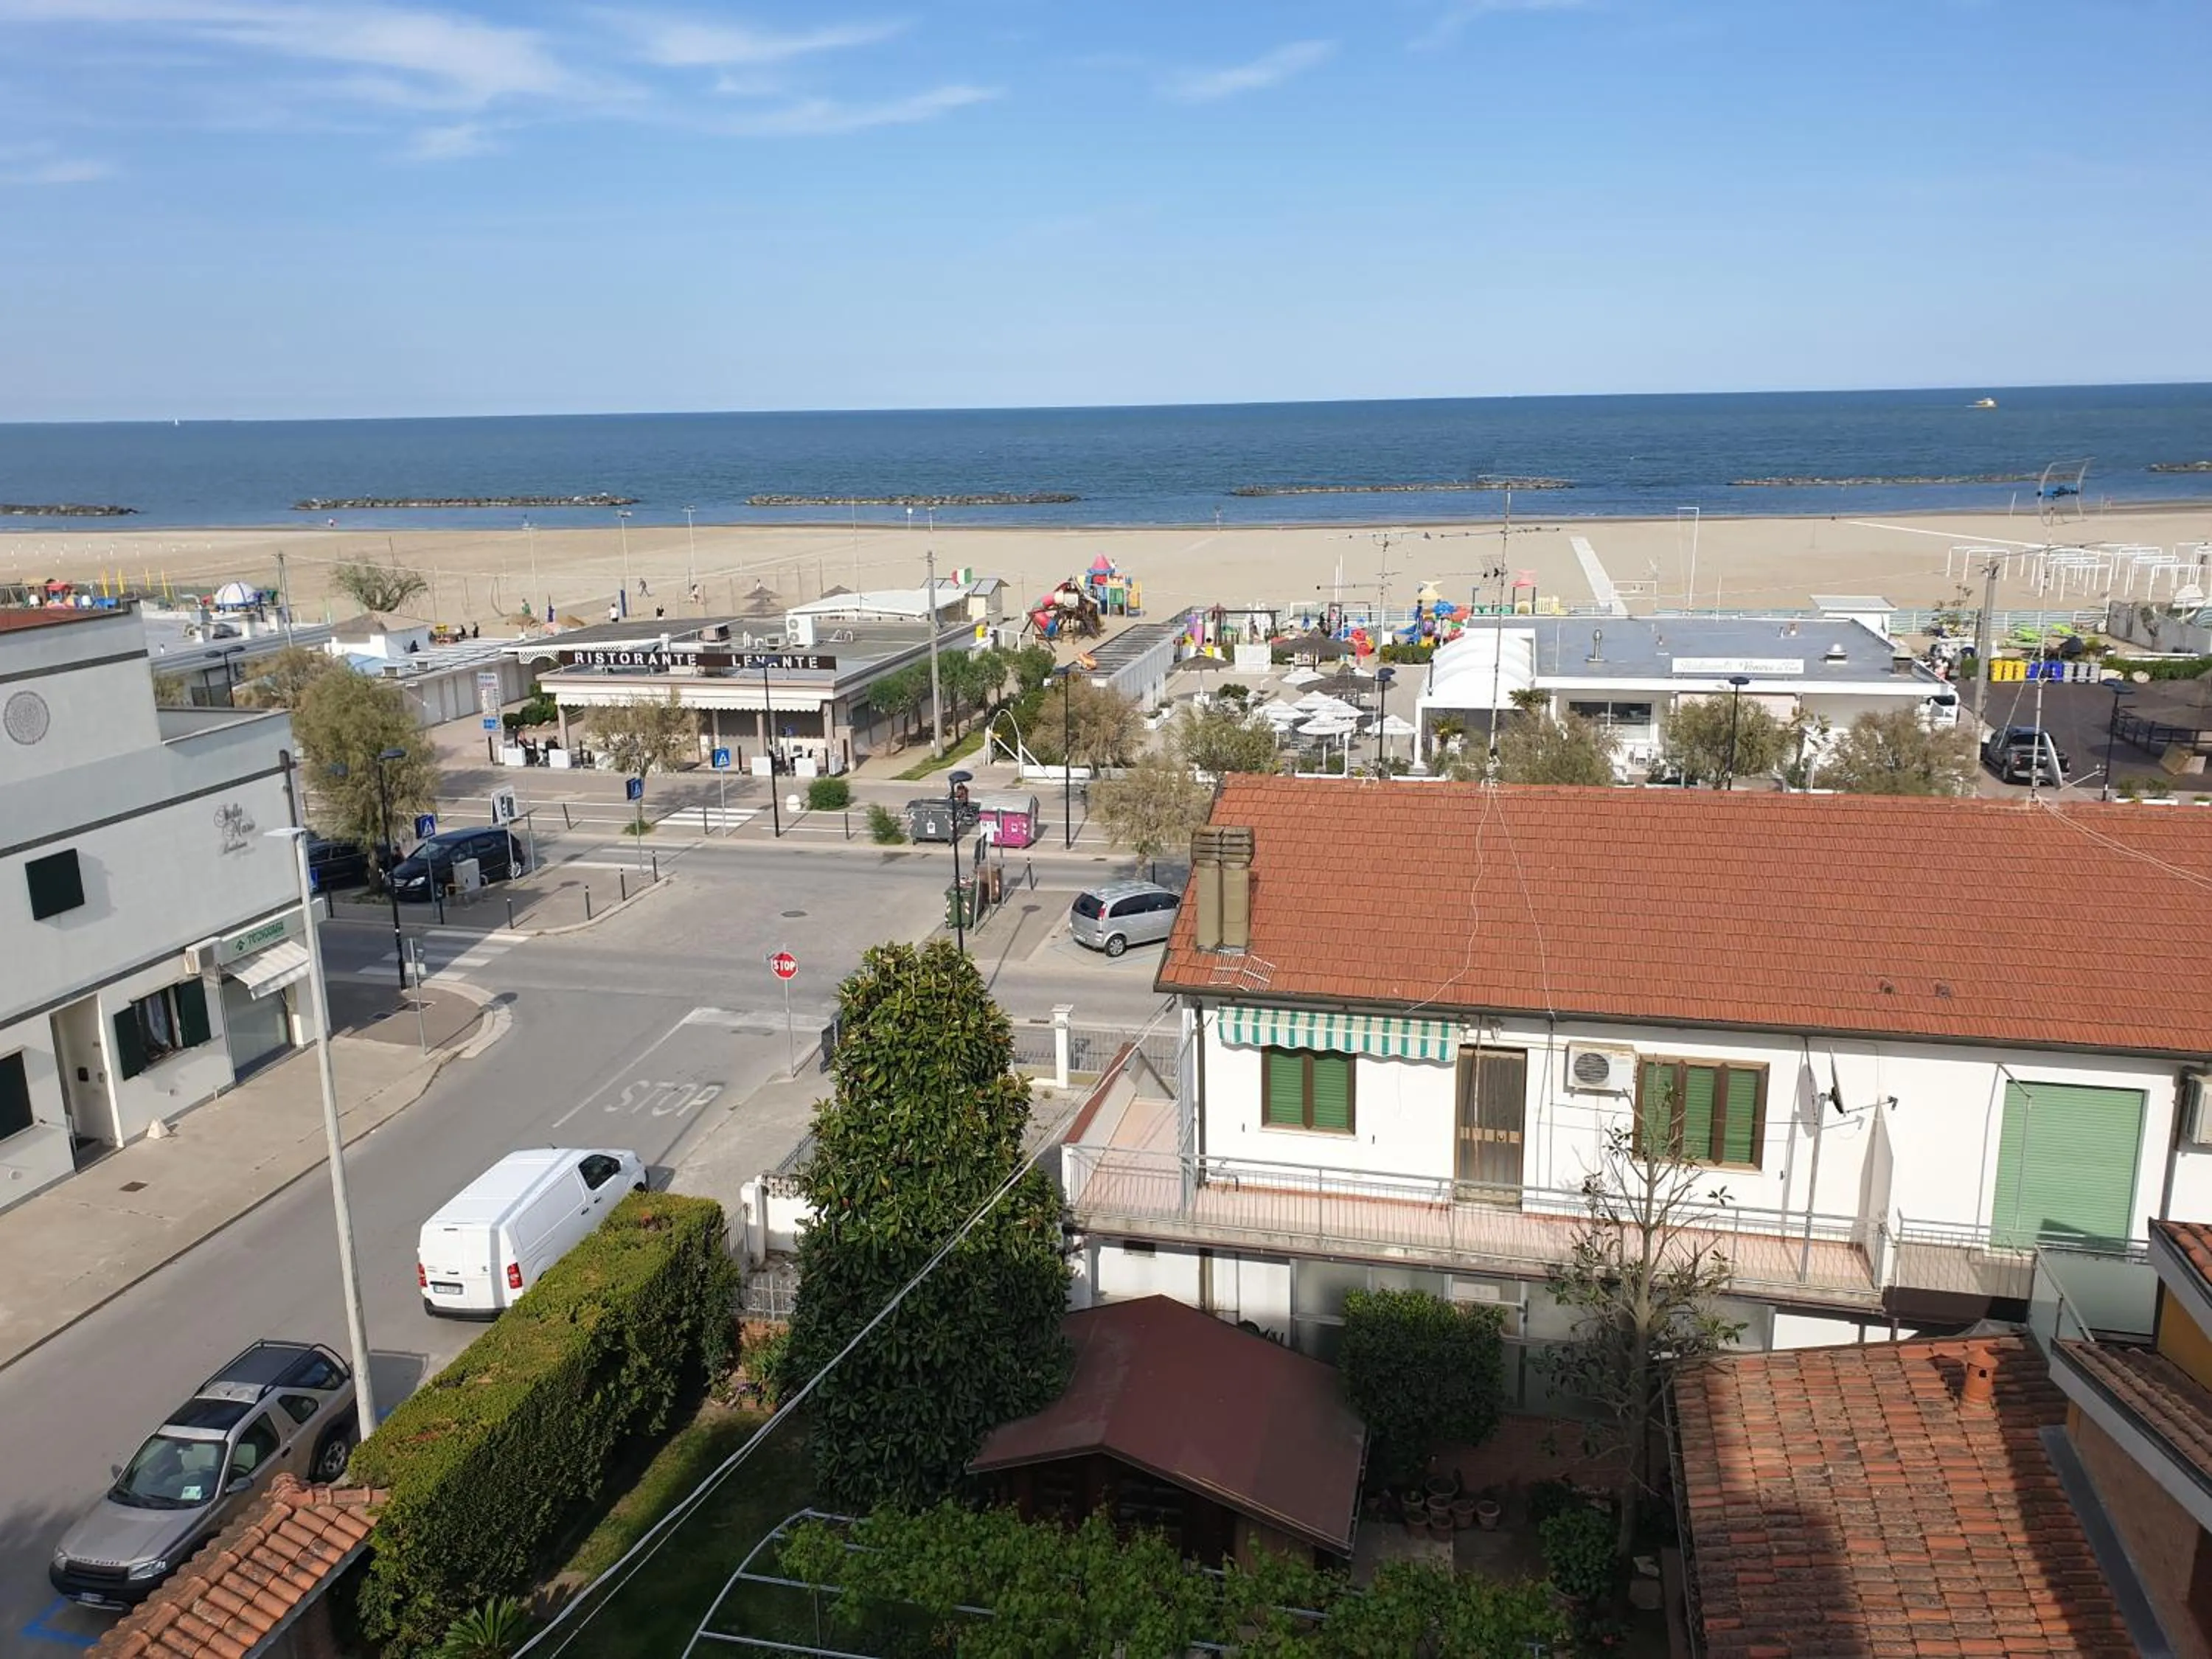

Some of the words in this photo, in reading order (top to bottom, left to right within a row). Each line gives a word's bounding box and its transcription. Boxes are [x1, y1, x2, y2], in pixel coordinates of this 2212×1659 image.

[574, 653, 698, 666] RISTORANTE
[773, 959, 796, 971] STOP
[604, 1079, 724, 1116] STOP
